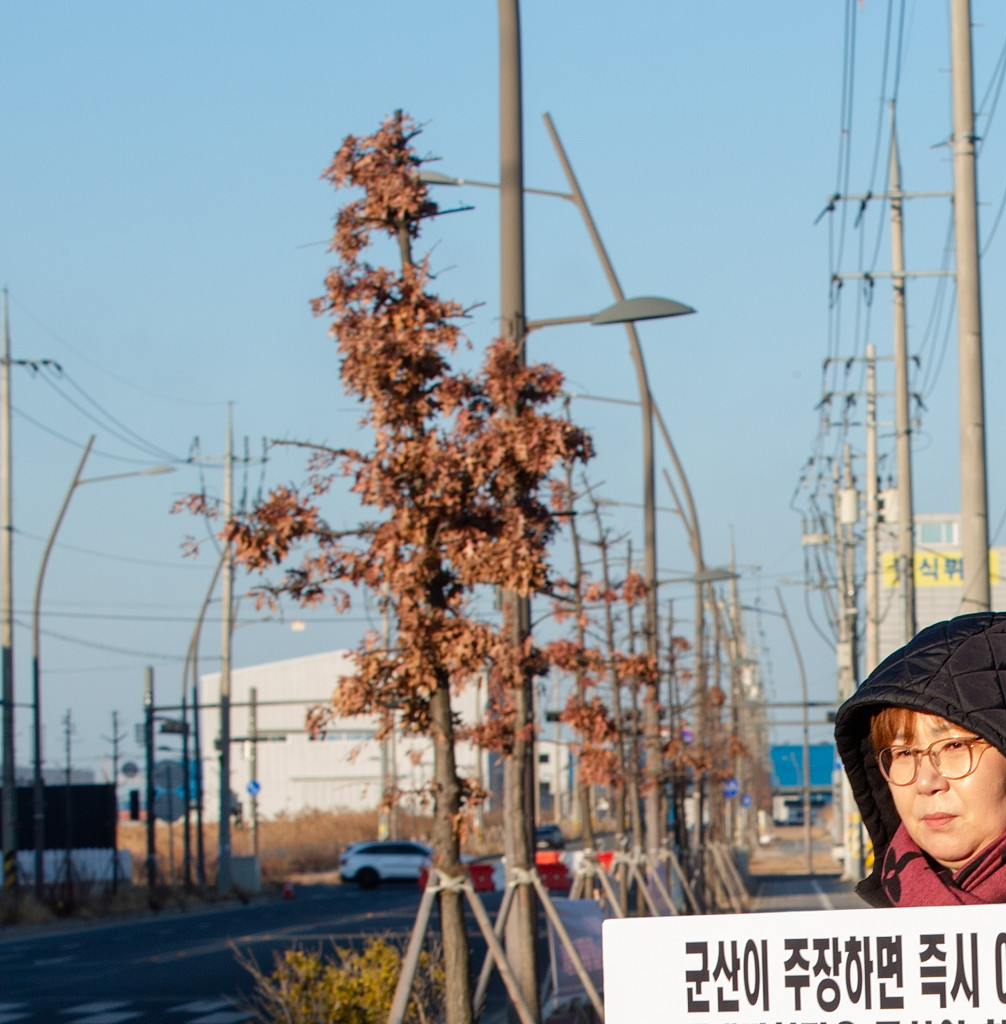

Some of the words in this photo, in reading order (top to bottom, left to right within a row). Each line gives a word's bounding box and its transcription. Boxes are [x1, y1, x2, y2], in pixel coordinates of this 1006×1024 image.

[684, 938, 770, 1013] 군산이
[783, 934, 905, 1013] 주장하면
[918, 932, 980, 1009] 즉시
